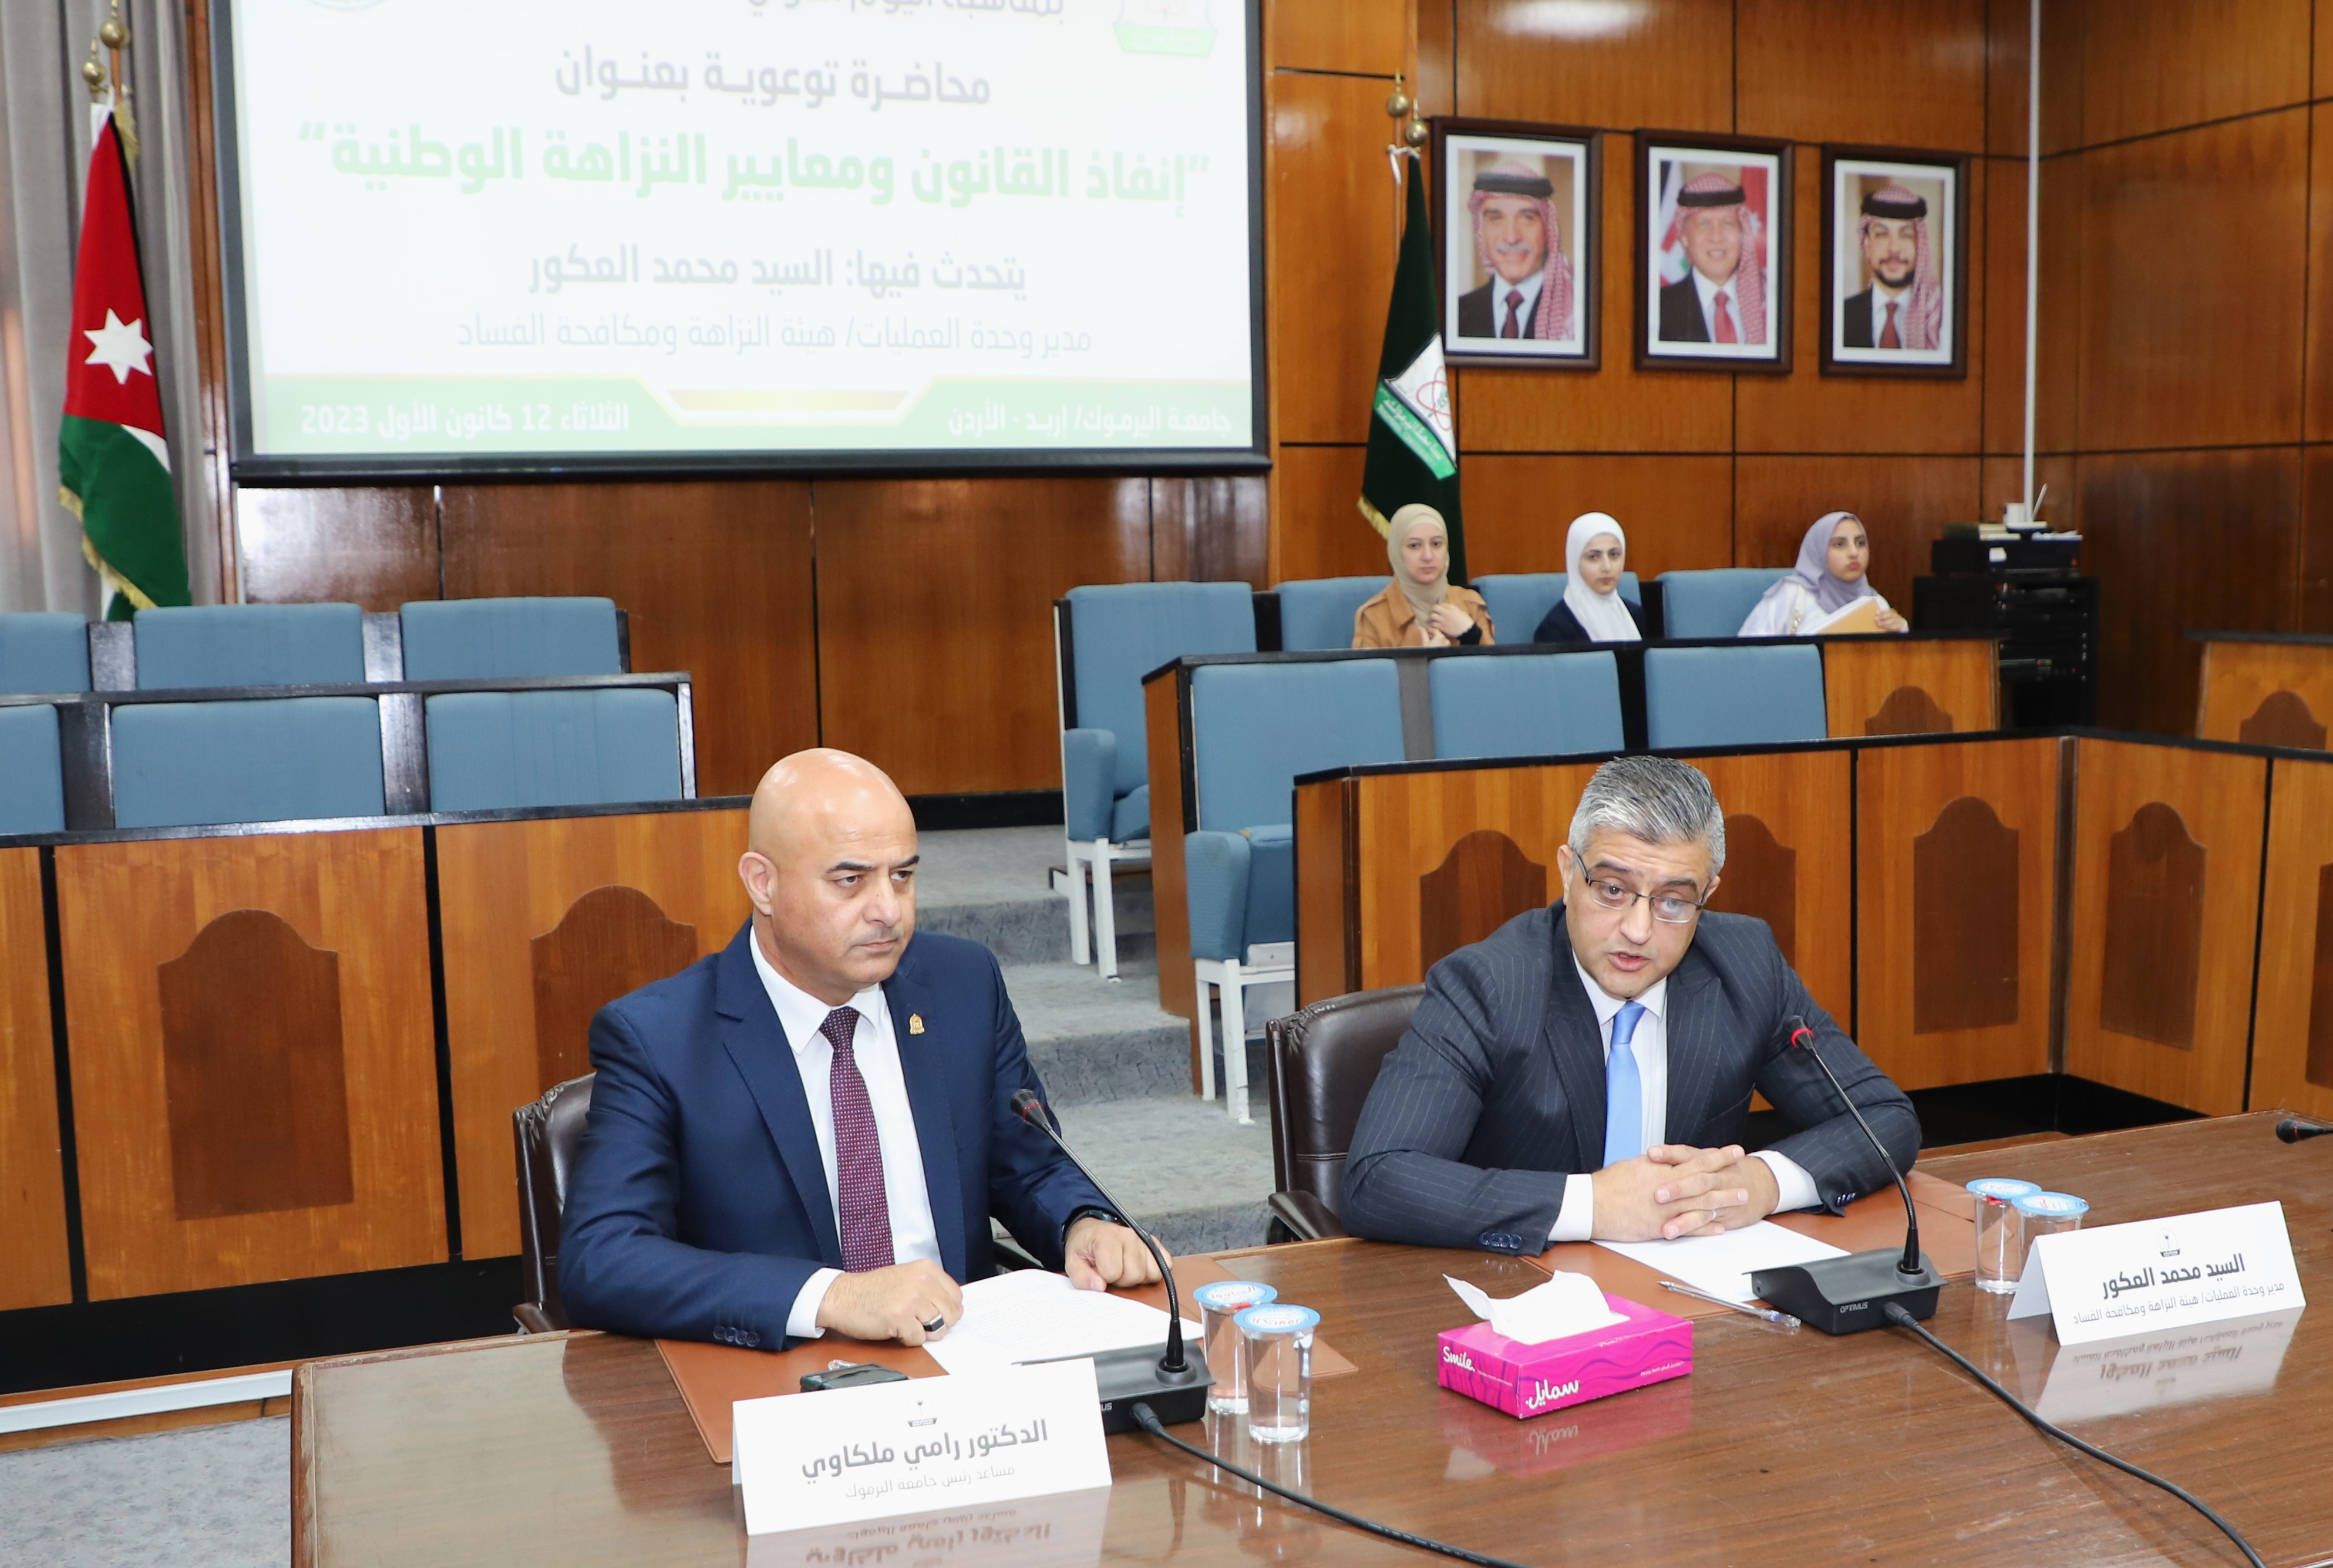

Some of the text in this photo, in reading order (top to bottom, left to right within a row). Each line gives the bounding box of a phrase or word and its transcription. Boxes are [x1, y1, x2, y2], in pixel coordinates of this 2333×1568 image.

[556, 45, 990, 112] محاضرة توعوية بعنوان
[543, 130, 706, 198] النزاهة
[722, 137, 894, 205] ومعايير
[912, 146, 1069, 208] القانون
[529, 244, 1026, 301] يتحدث فيها: السيد محمد العكور
[459, 312, 545, 346] الفساد
[557, 314, 678, 356] ومكافحة
[689, 315, 770, 356] النزاهة
[782, 316, 836, 355] هيئة
[971, 321, 1033, 359] وحدة
[1042, 330, 1090, 359] مدير
[301, 399, 630, 440] الثلاثاء 12 كانون الأول 2023
[949, 399, 1005, 437] الأردن
[1167, 407, 1231, 438] جامعة
[2103, 1253, 2246, 1300] السيد محمد العكور
[2243, 1286, 2264, 1297] وحدة
[2267, 1283, 2284, 1296] مدير
[1840, 1301, 1869, 1313] OPTIMUS
[2073, 1309, 2102, 1324] الفساد
[2106, 1304, 2146, 1316] ومكافحة
[2148, 1296, 2177, 1313] النزاهة
[2180, 1295, 2199, 1309] هيئة
[1443, 1346, 1474, 1372] Smile
[1528, 1379, 1578, 1409] سمايل
[802, 1418, 1048, 1485] الدكتور رامي ملكاوي
[846, 1465, 1015, 1500] مساعد رئيس جامعة اليرموك
